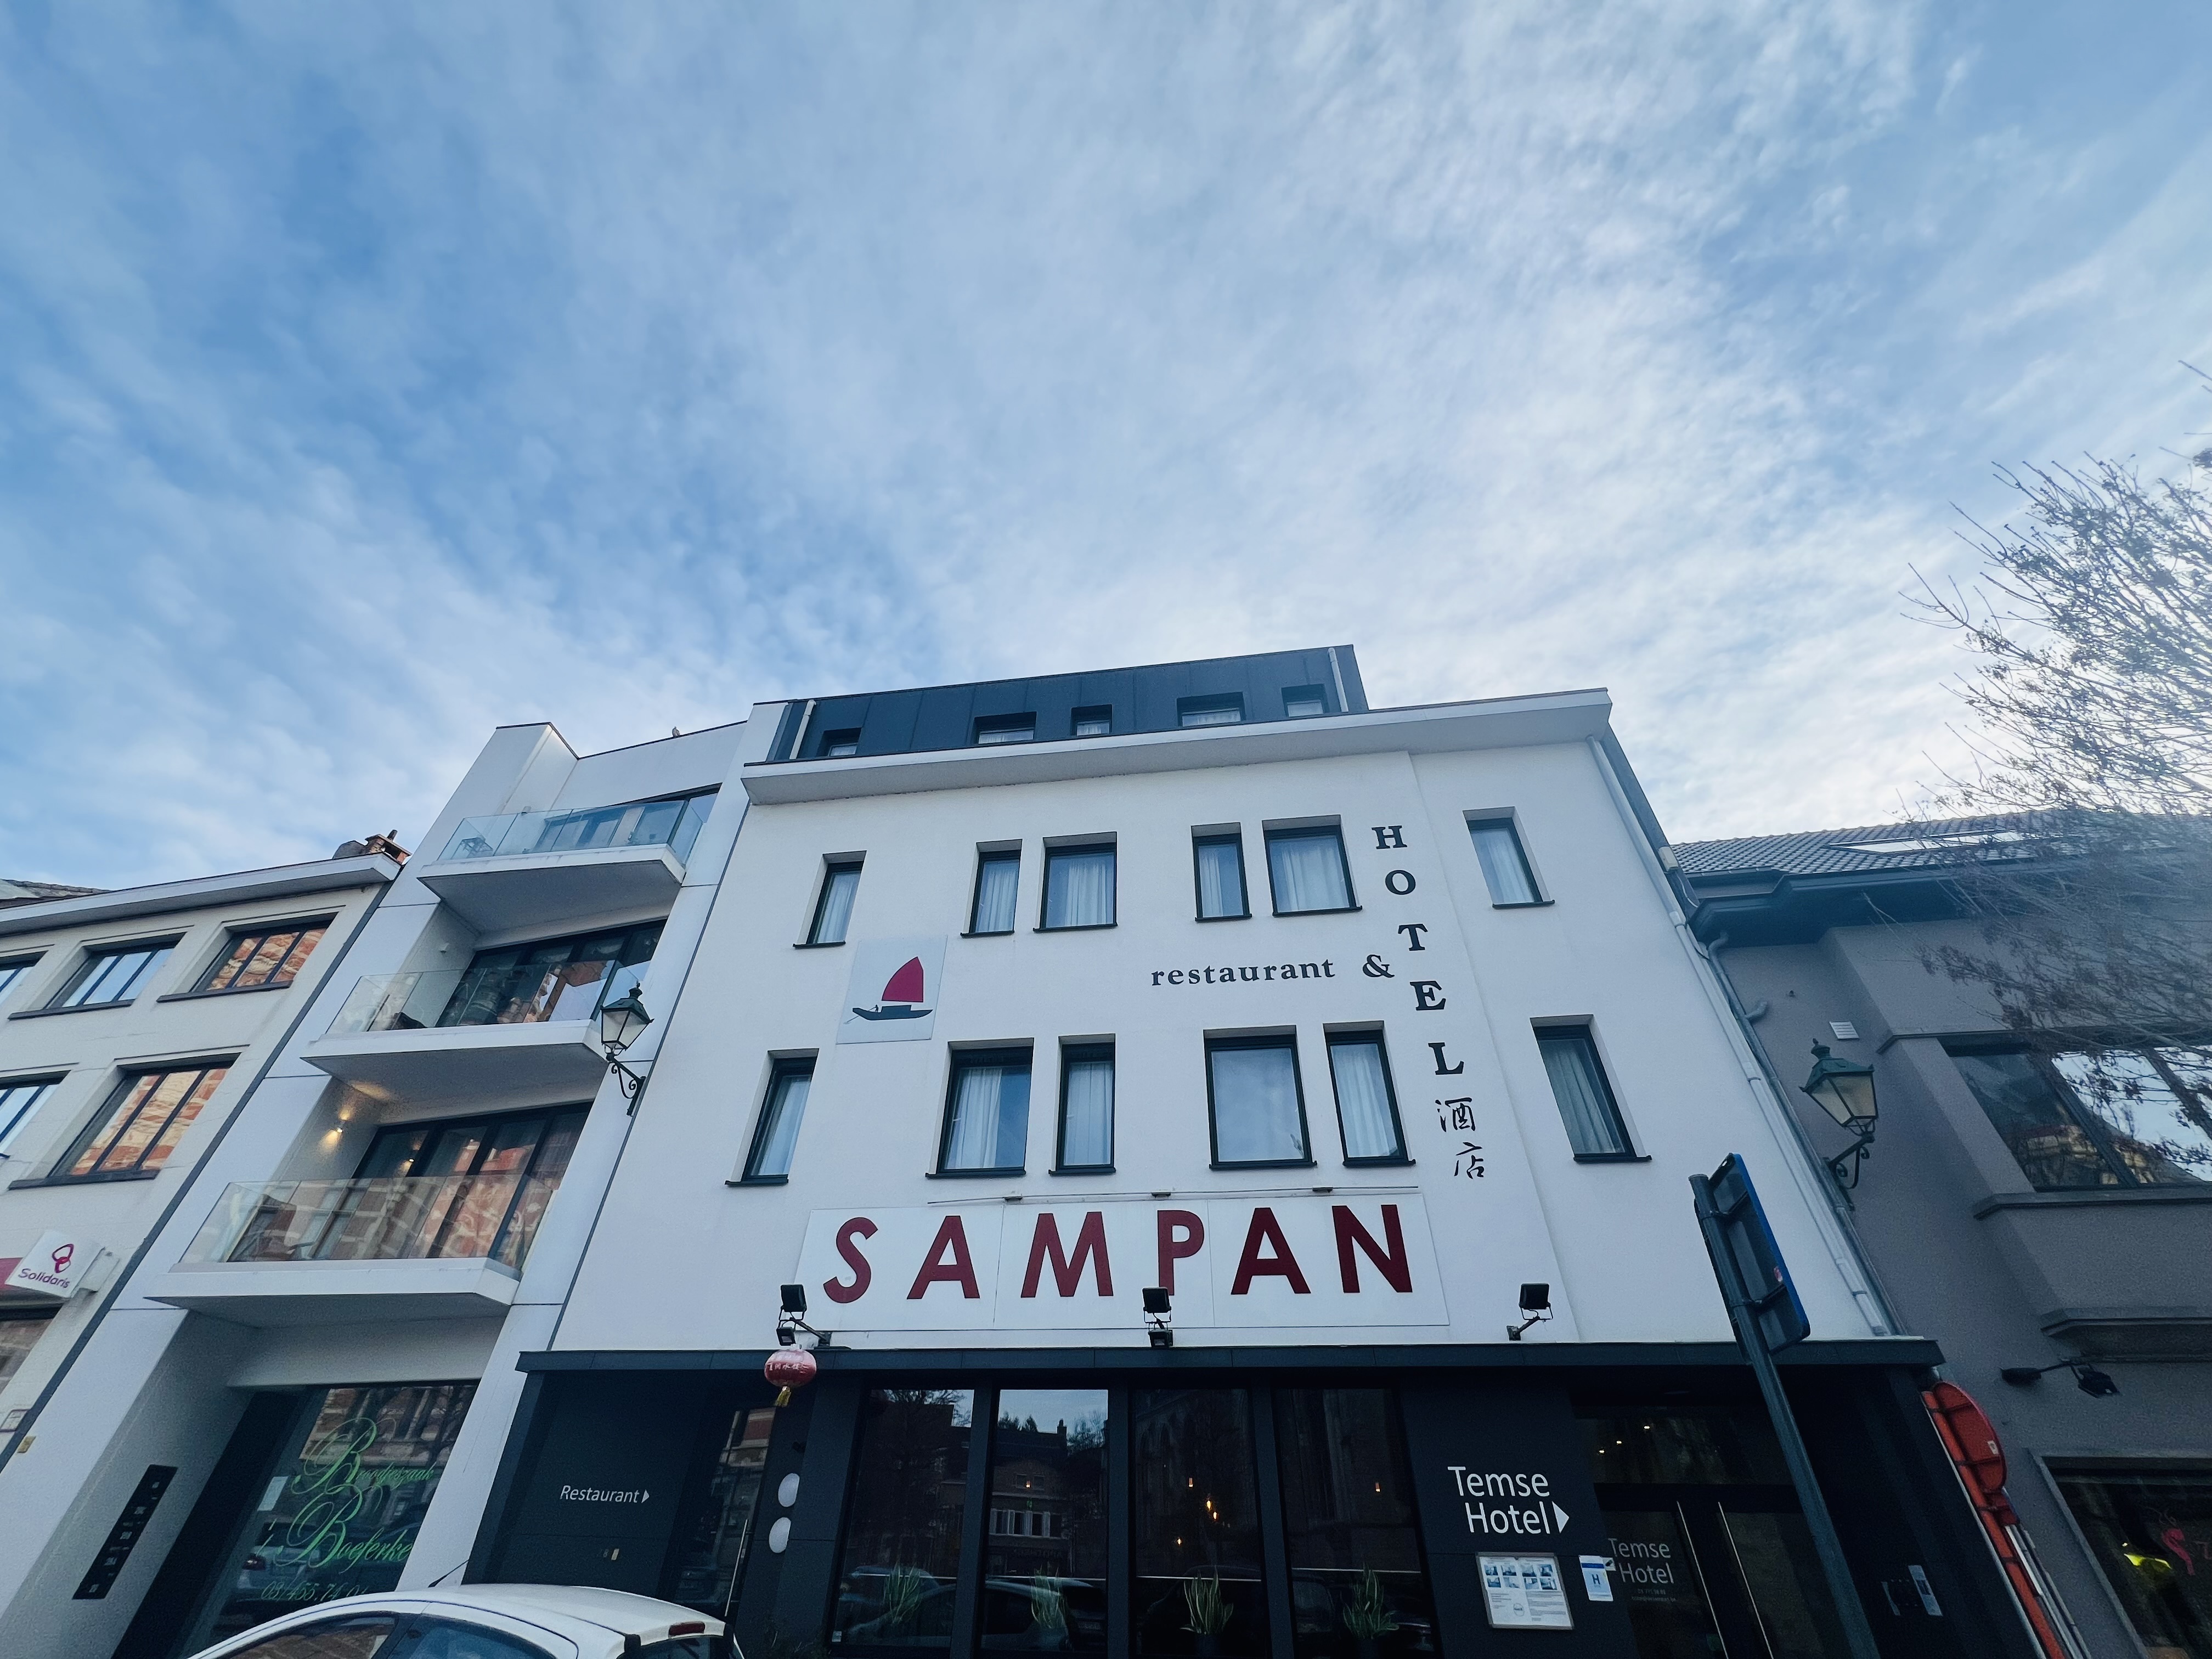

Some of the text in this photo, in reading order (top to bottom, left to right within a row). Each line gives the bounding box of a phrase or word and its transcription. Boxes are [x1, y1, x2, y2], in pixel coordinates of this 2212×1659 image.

[1371, 825, 1464, 1075] HOTEL
[1151, 954, 1395, 986] restaurant &
[1435, 1097, 1485, 1180] 酒店
[823, 1204, 1413, 1304] SAMPAN
[18, 1268, 70, 1289] Solidaris
[560, 1485, 640, 1503] Restaurant
[1447, 1466, 1550, 1497] Temse
[1465, 1500, 1550, 1534] Hotel
[1608, 1538, 1671, 1559] Temse
[1618, 1562, 1674, 1584] Hotel
